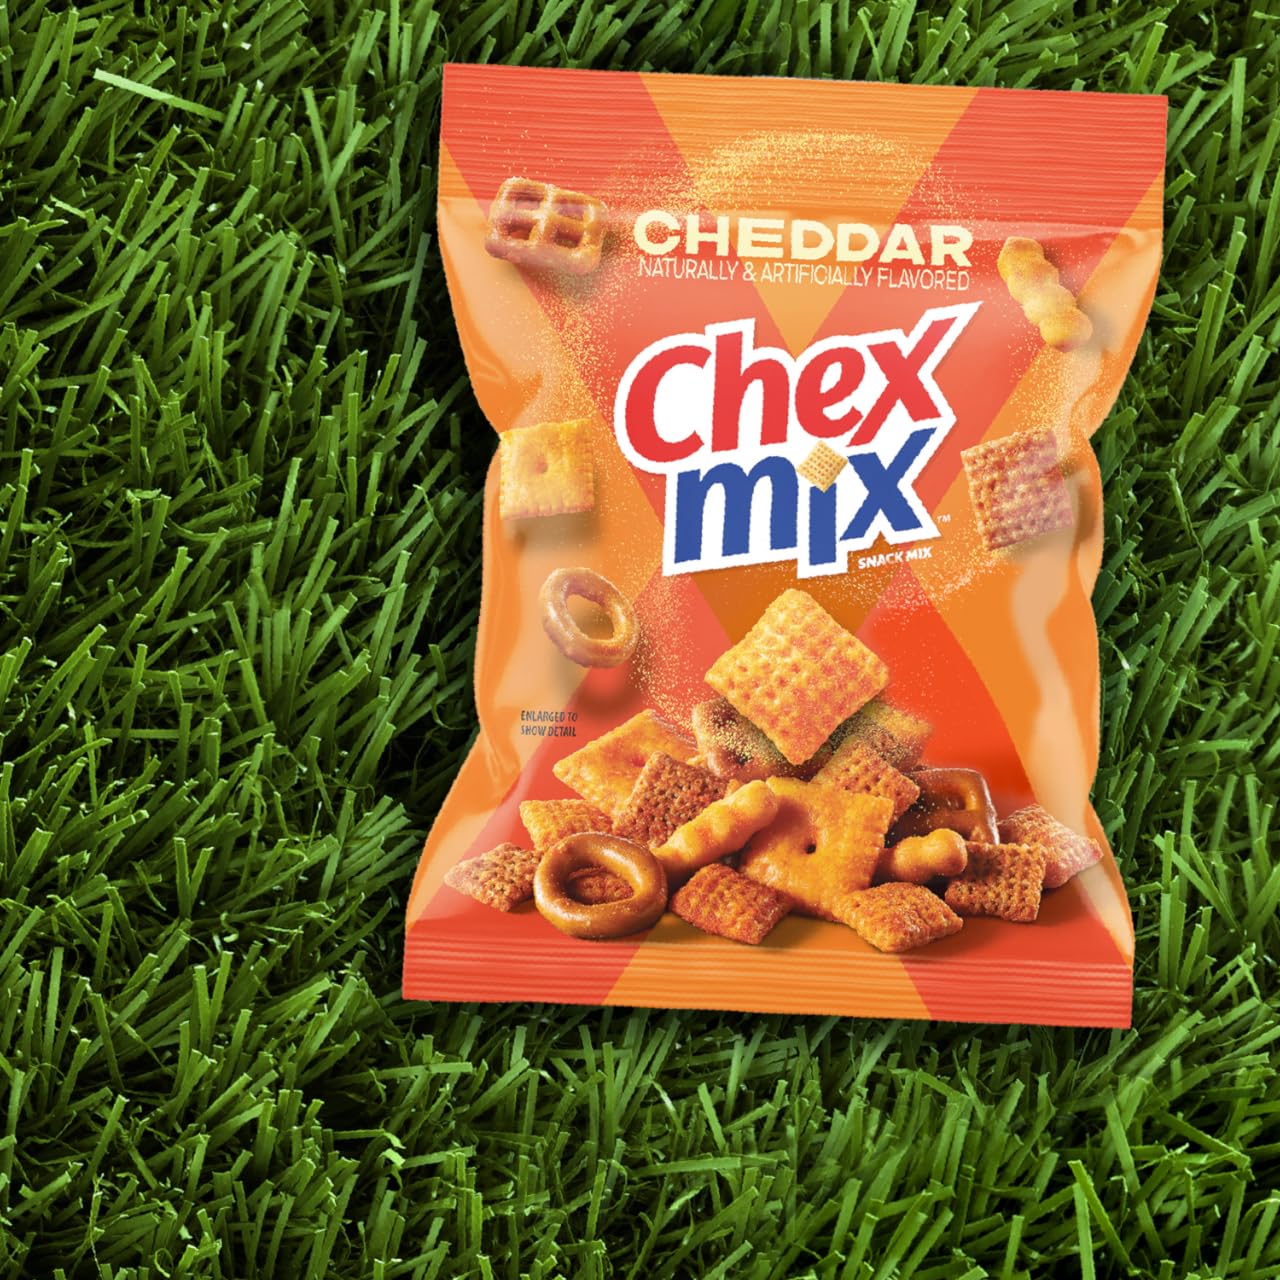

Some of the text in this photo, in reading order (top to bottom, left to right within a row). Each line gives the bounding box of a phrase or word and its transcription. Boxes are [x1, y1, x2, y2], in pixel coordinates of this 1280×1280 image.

[634, 209, 974, 268] CHEDDAR
[638, 256, 971, 291] NATURALLY & ARTIFICIALLY FLAVORED
[620, 310, 970, 466] Chex
[672, 425, 939, 568] mix
[858, 546, 933, 570] SNACK MIX
[520, 710, 578, 722] ENLARGED TO
[520, 725, 576, 737] SHOW DETAIL
